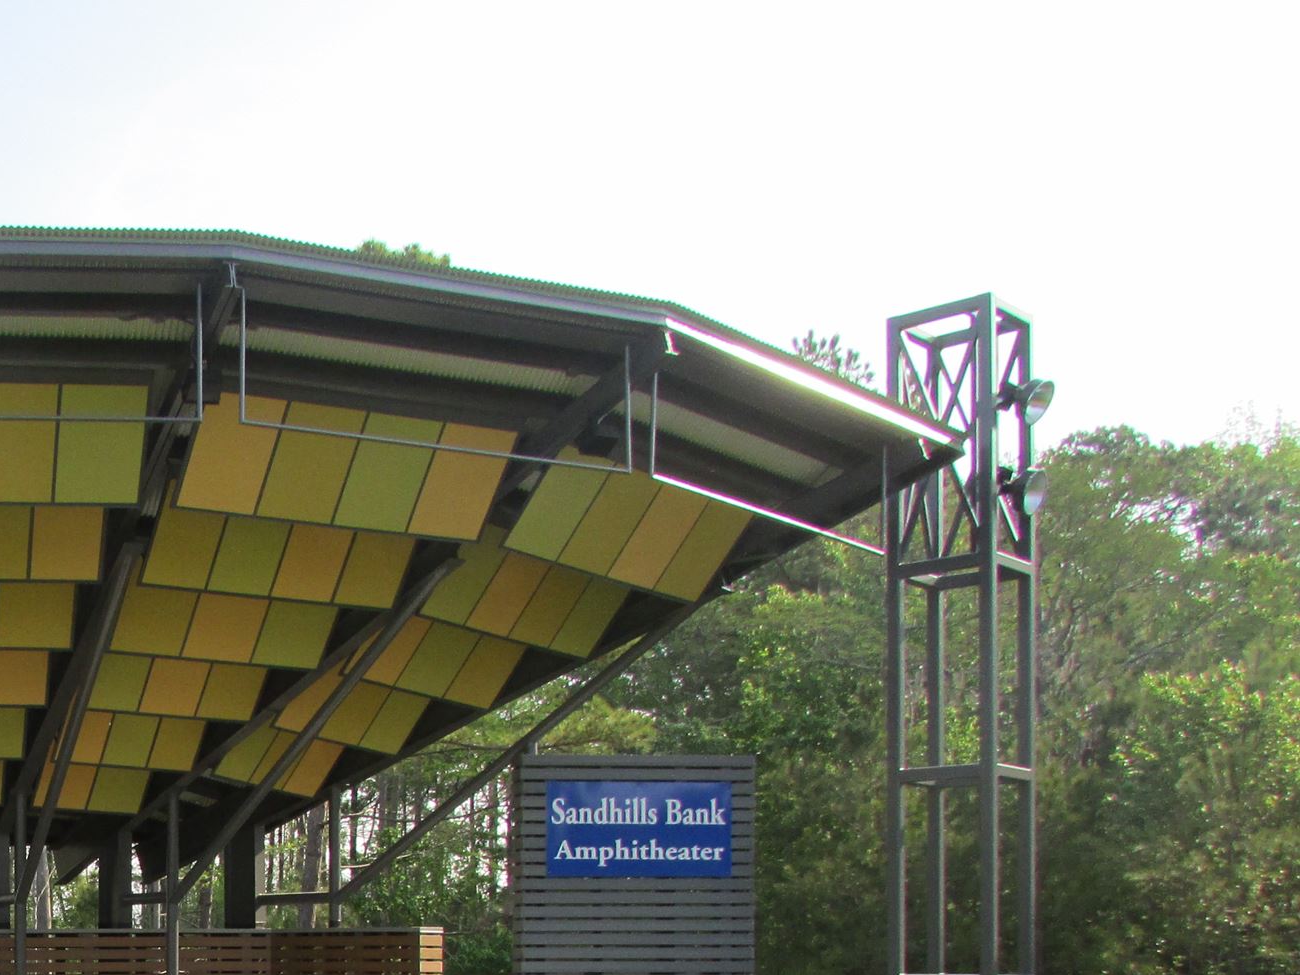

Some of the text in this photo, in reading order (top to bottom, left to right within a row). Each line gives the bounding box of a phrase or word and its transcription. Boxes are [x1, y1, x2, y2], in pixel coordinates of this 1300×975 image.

[551, 797, 726, 825] Sandhills Bank
[554, 838, 724, 867] Amphitheater
